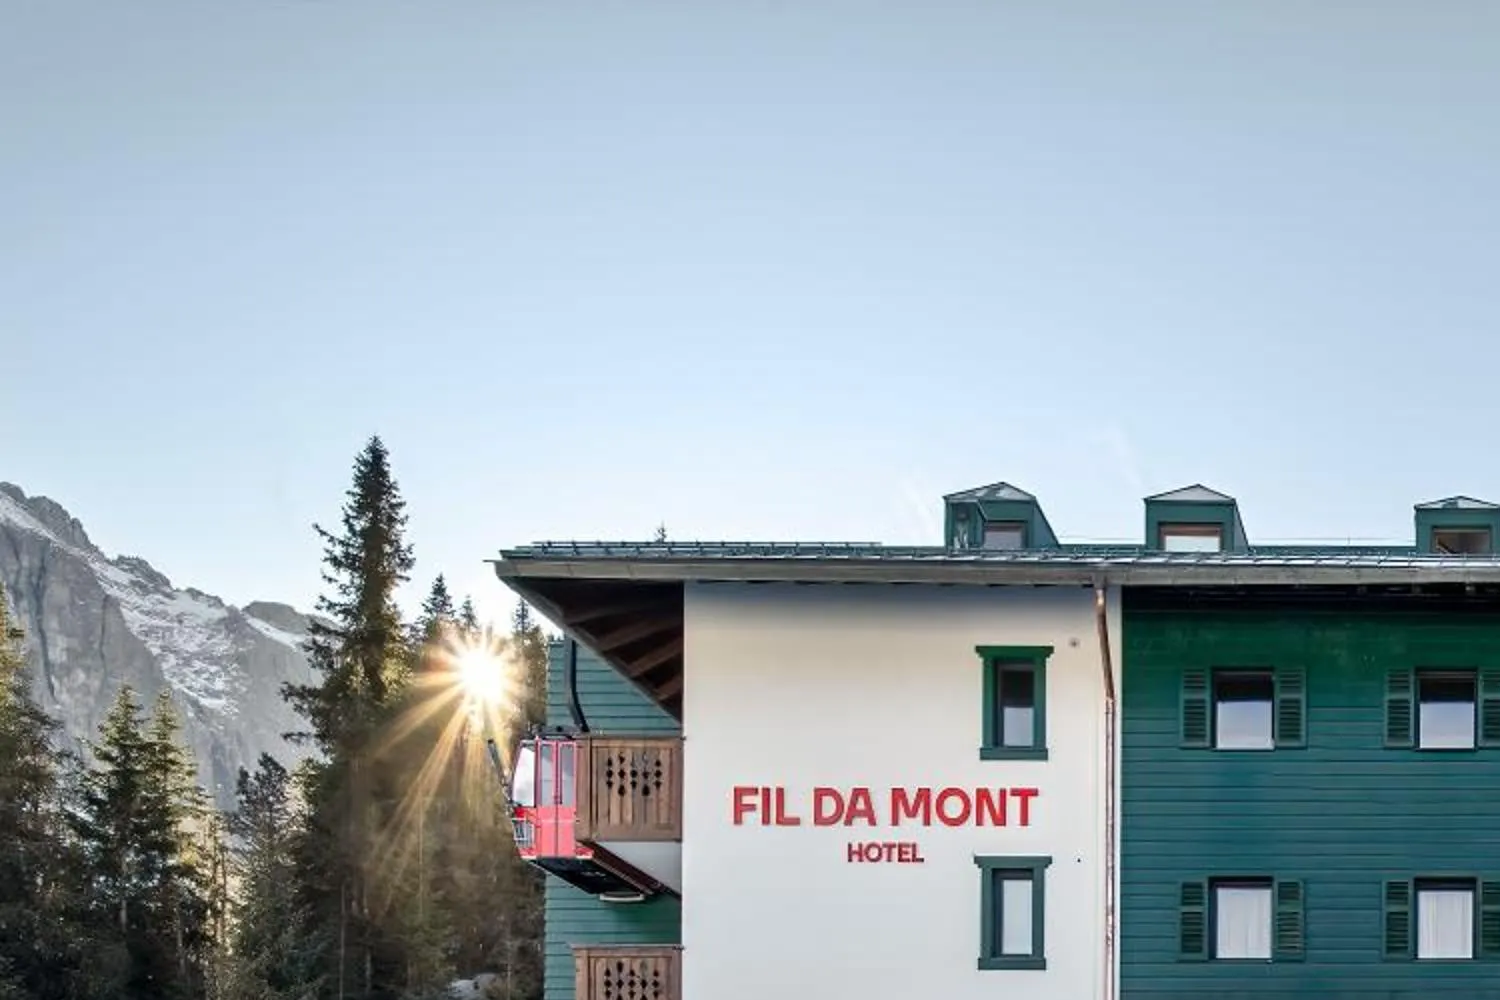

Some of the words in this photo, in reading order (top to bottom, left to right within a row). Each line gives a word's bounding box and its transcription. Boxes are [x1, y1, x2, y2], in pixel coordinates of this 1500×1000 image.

[732, 786, 800, 826] FIL
[813, 786, 877, 827] DA
[889, 786, 1039, 827] MONT
[847, 842, 924, 863] HOTEL
